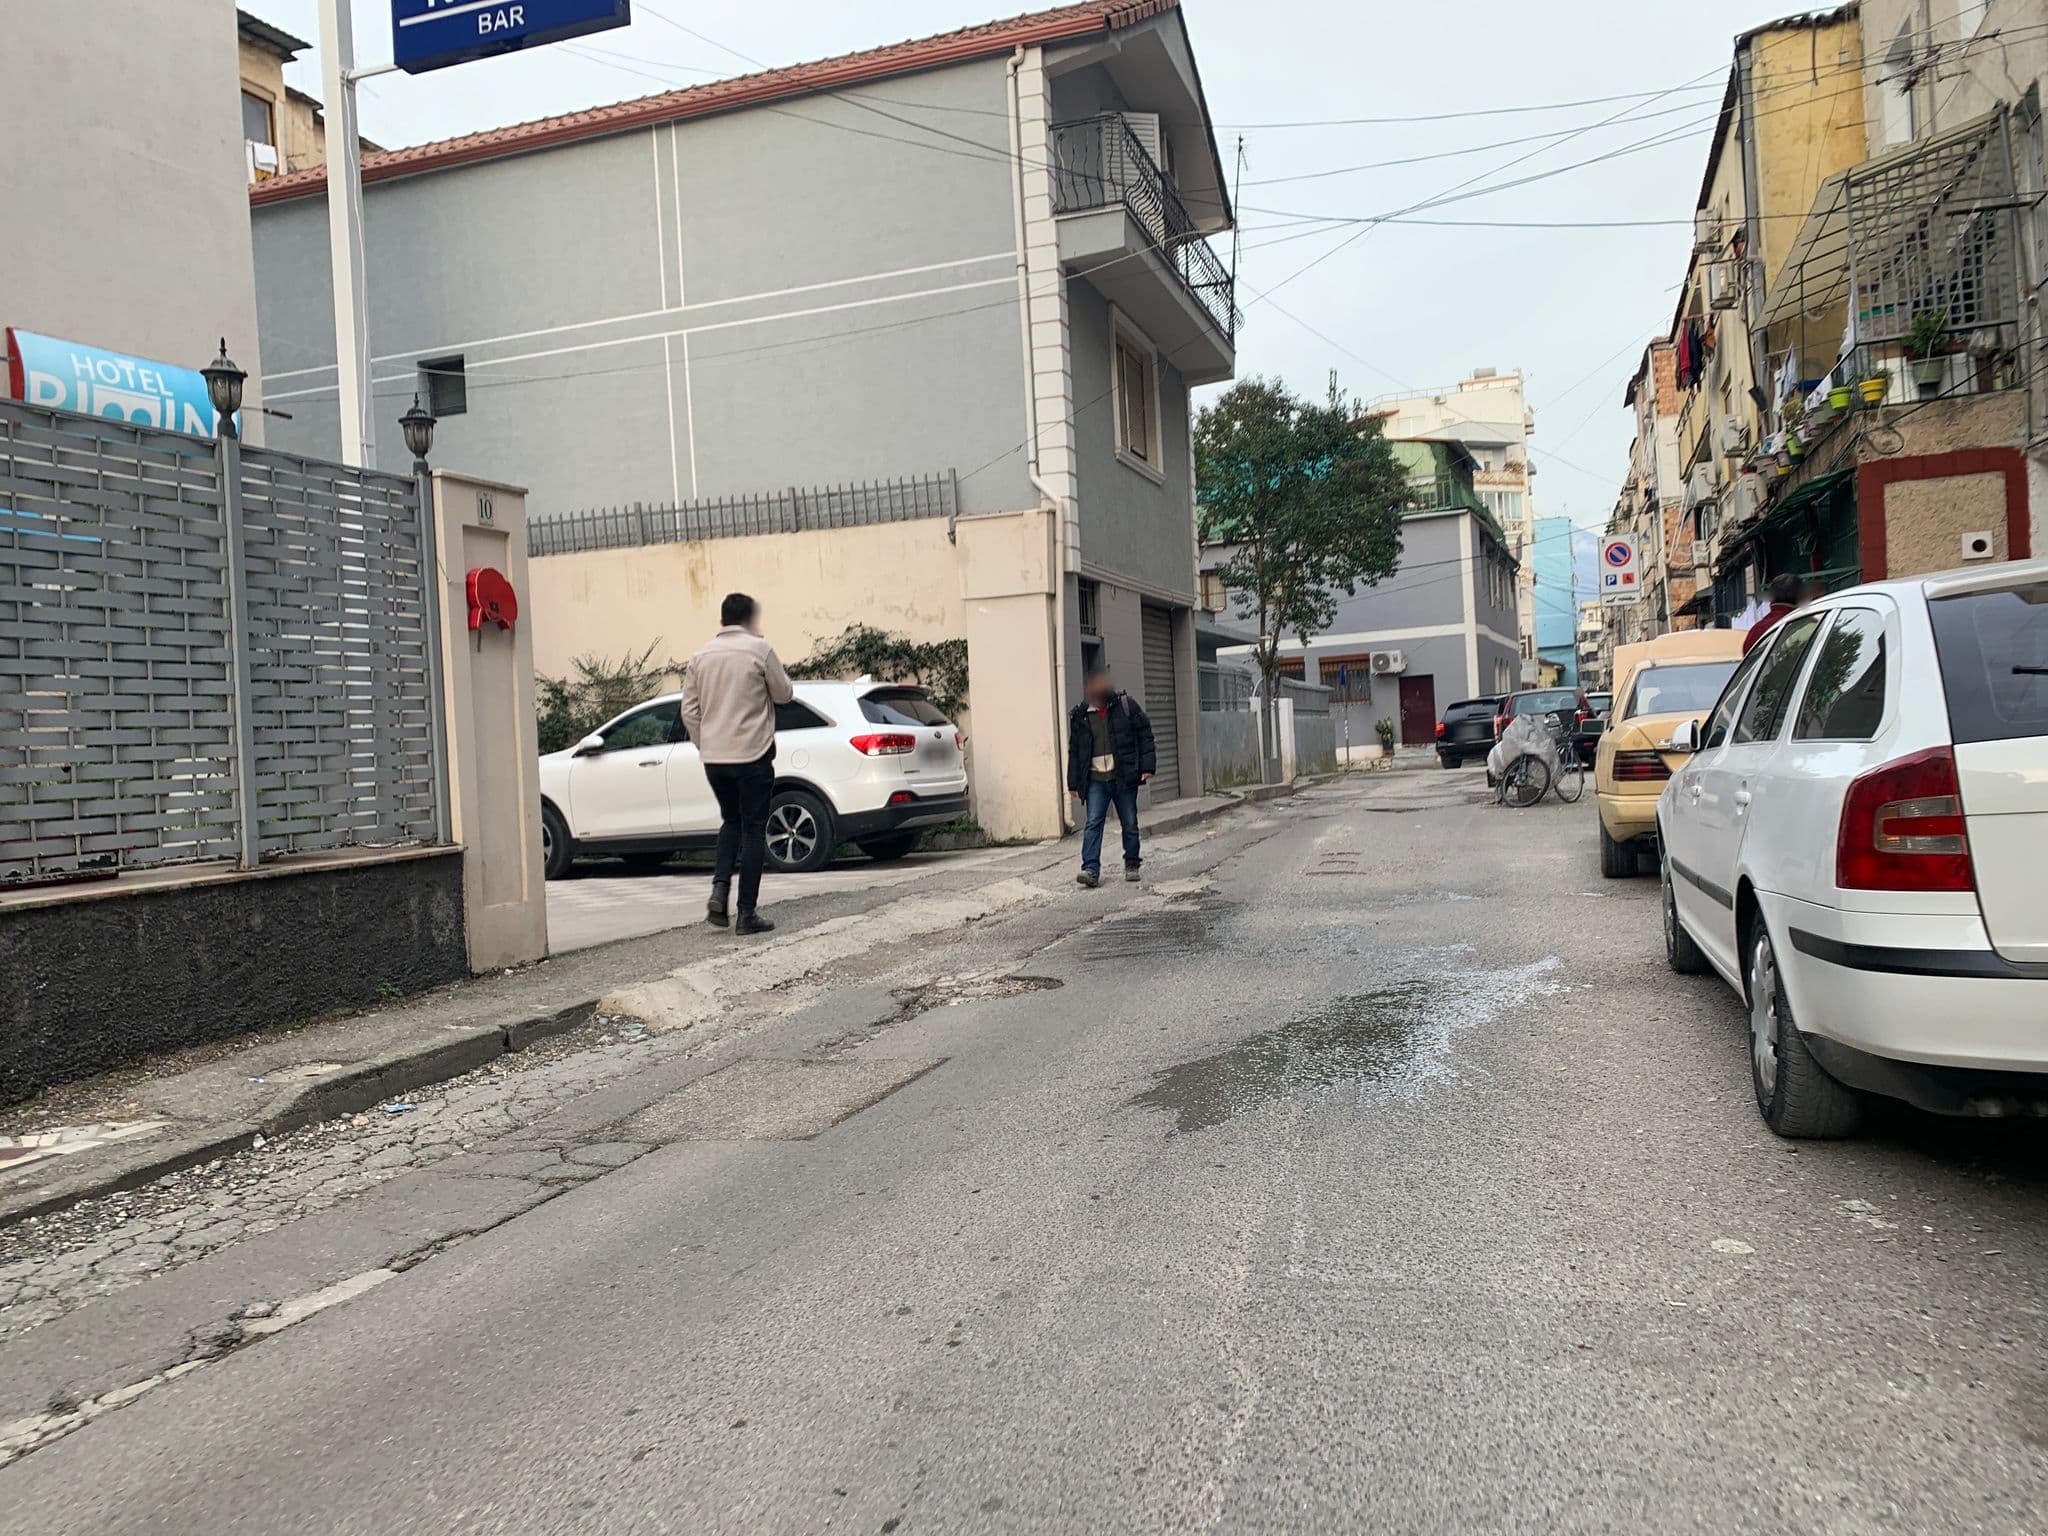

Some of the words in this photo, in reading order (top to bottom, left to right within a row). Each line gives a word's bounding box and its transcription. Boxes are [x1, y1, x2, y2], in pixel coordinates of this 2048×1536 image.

[478, 5, 524, 35] BAR
[70, 353, 174, 396] HOTEL
[480, 498, 492, 519] 10
[1607, 574, 1615, 586] P
